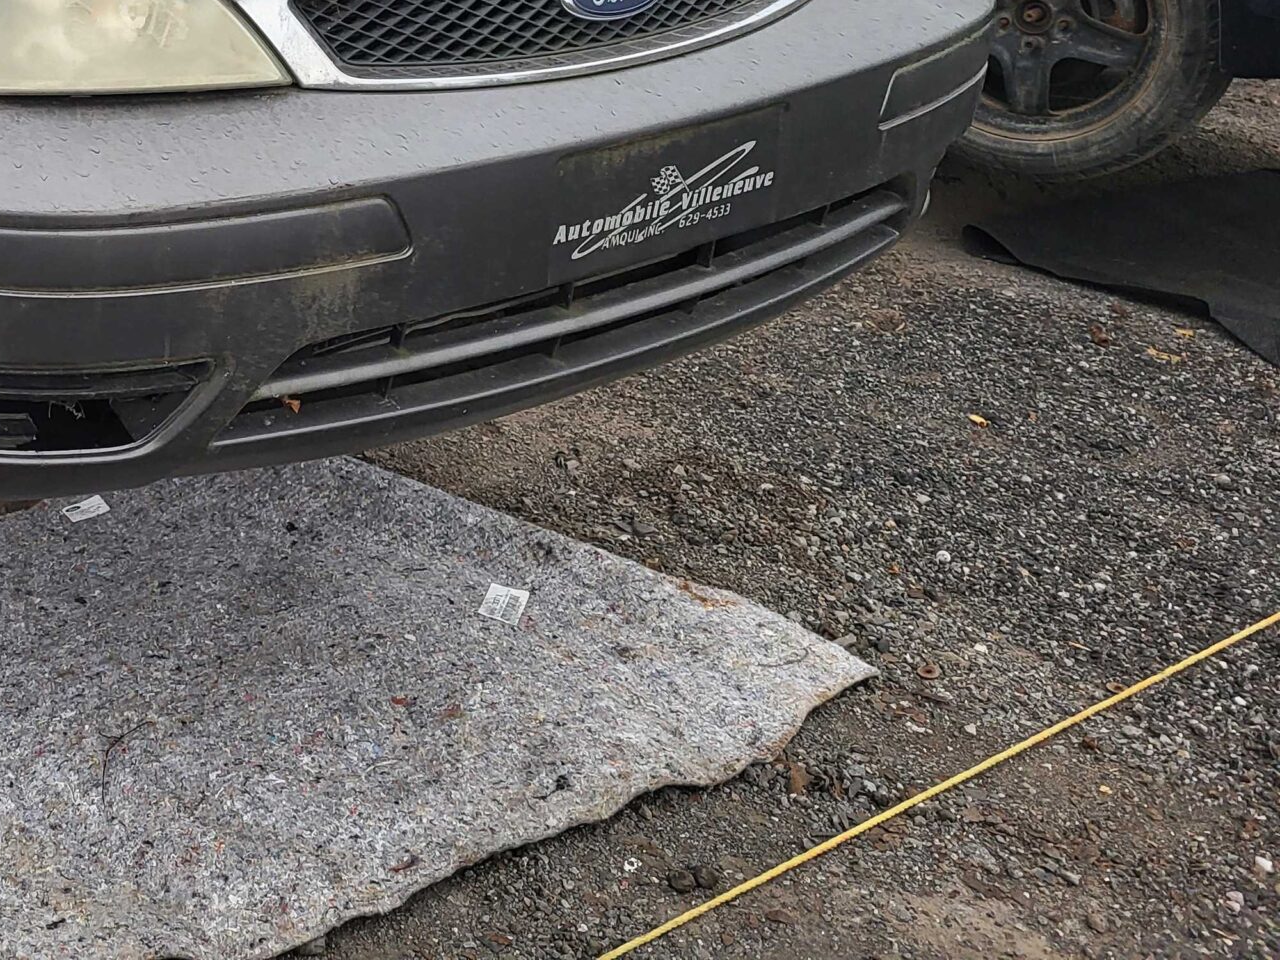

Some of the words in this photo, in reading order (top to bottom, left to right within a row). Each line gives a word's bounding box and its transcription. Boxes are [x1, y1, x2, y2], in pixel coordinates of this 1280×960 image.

[553, 199, 671, 245] Automobile
[681, 170, 774, 210] Villeneuve
[678, 202, 731, 229] 629-4533
